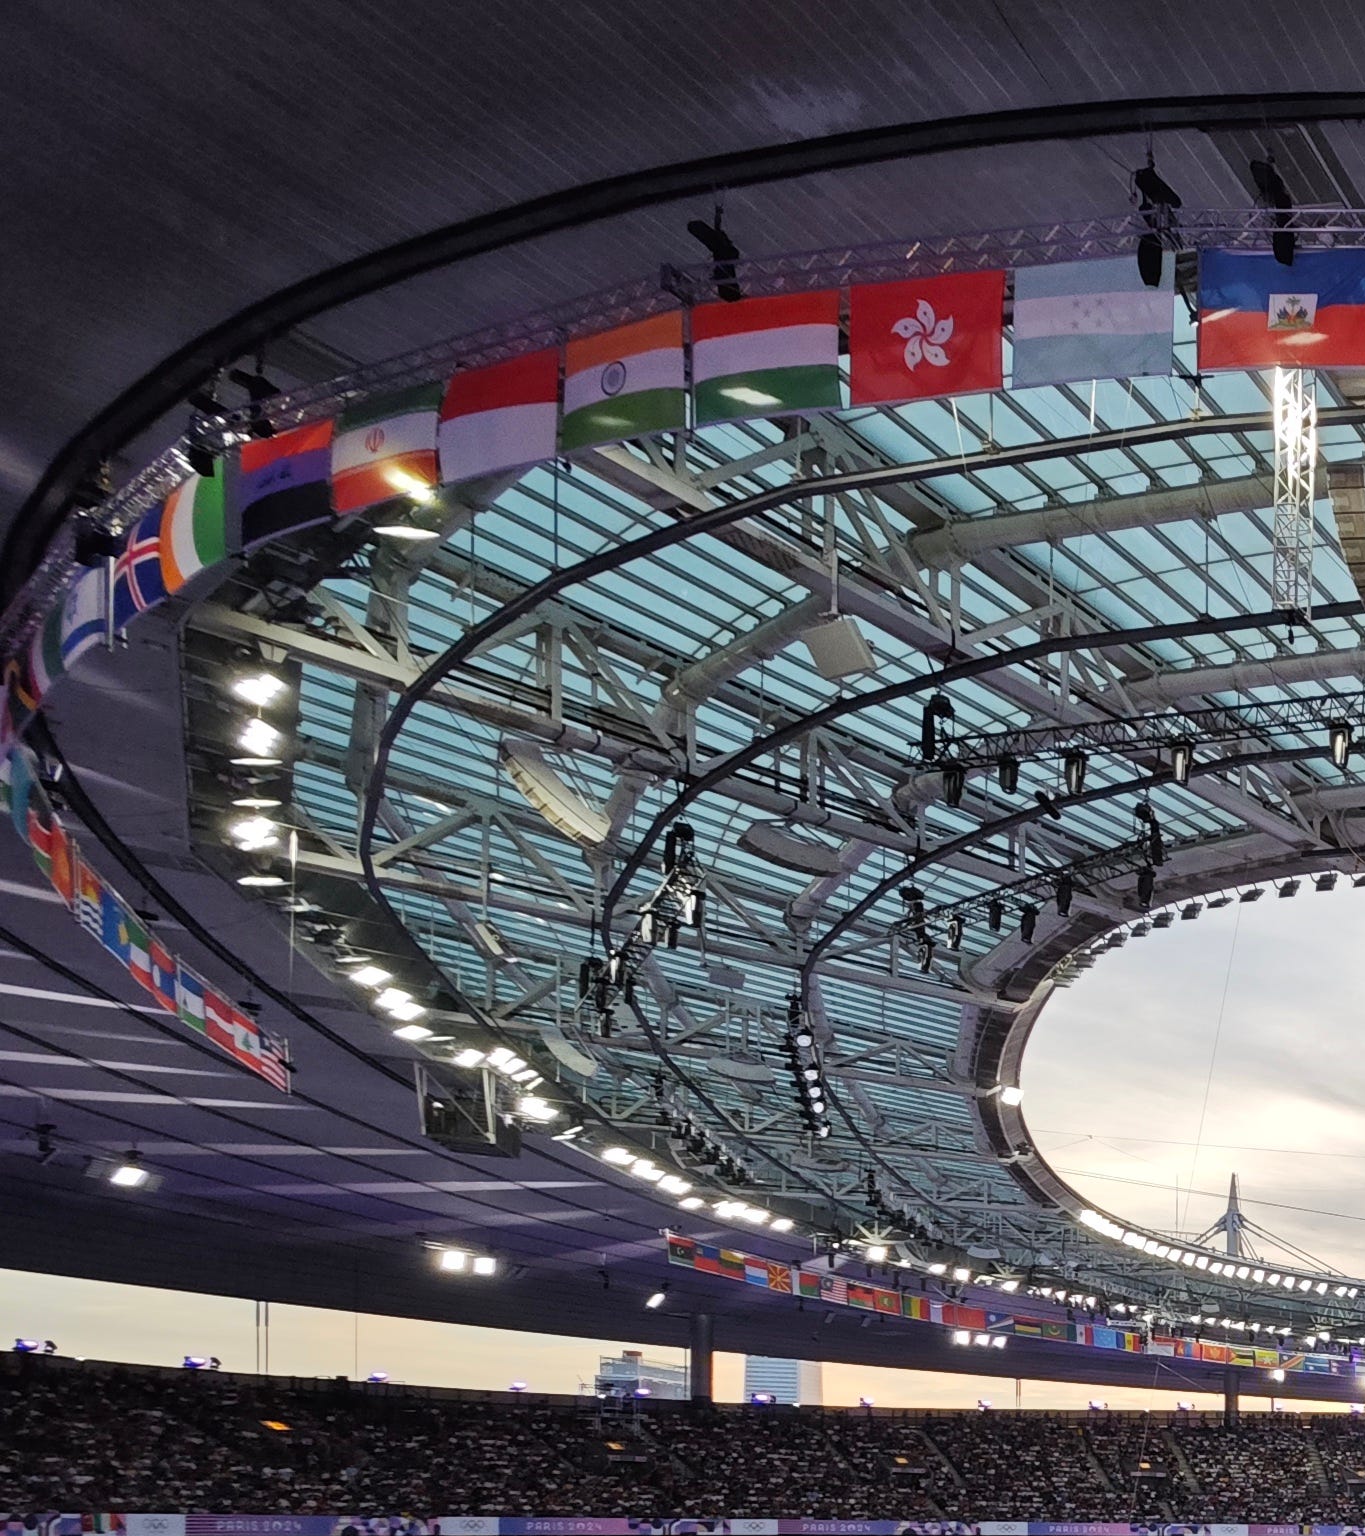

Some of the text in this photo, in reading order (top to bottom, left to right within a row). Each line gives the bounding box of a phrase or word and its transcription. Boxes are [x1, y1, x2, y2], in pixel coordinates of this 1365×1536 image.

[216, 1519, 302, 1532] PARIS 2024
[526, 1520, 602, 1533] PARIS 2024
[803, 1522, 871, 1533] PARIS 2024
[1049, 1524, 1109, 1533] PARIS 2024
